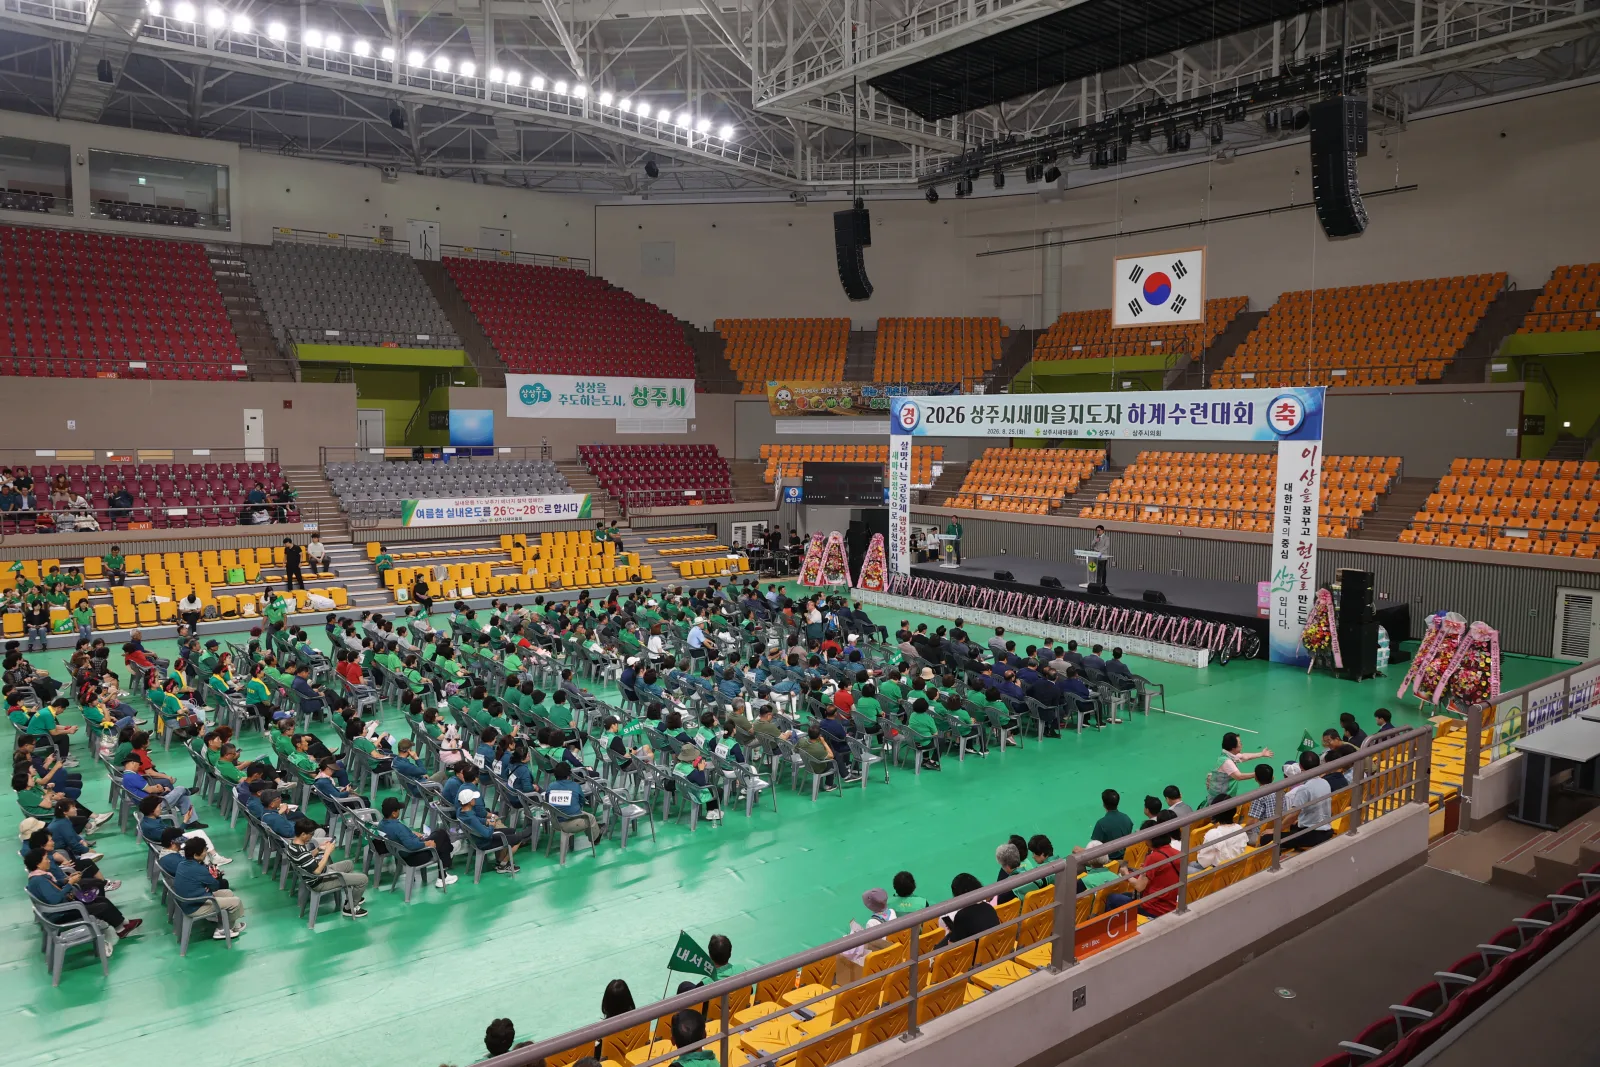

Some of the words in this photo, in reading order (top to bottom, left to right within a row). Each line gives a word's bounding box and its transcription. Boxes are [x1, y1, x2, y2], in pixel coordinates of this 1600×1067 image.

[521, 386, 547, 400] 상상주도
[574, 382, 606, 394] 상상을
[630, 386, 686, 408] 상주시
[902, 408, 915, 424] 경
[926, 406, 965, 423] 2026
[970, 403, 1122, 425] 상주시새마을지도자
[1128, 401, 1253, 425] 하계수련대회
[1275, 403, 1296, 427] 축
[900, 441, 909, 481] 살맛나는
[1299, 445, 1317, 503] 이상을
[416, 508, 444, 519] 여름철
[446, 506, 491, 518] 실내온도를
[554, 503, 578, 513] 합시다
[899, 484, 907, 513] 공동체
[1282, 483, 1293, 537] 대한민국의
[899, 516, 907, 555] 행복상주
[1301, 506, 1312, 536] 꿈꾸고
[1281, 539, 1289, 559] 중심
[1297, 540, 1313, 590] 현실로
[1298, 595, 1308, 625] 만드는
[1107, 909, 1128, 938] C1
[676, 947, 714, 976] 내서면
